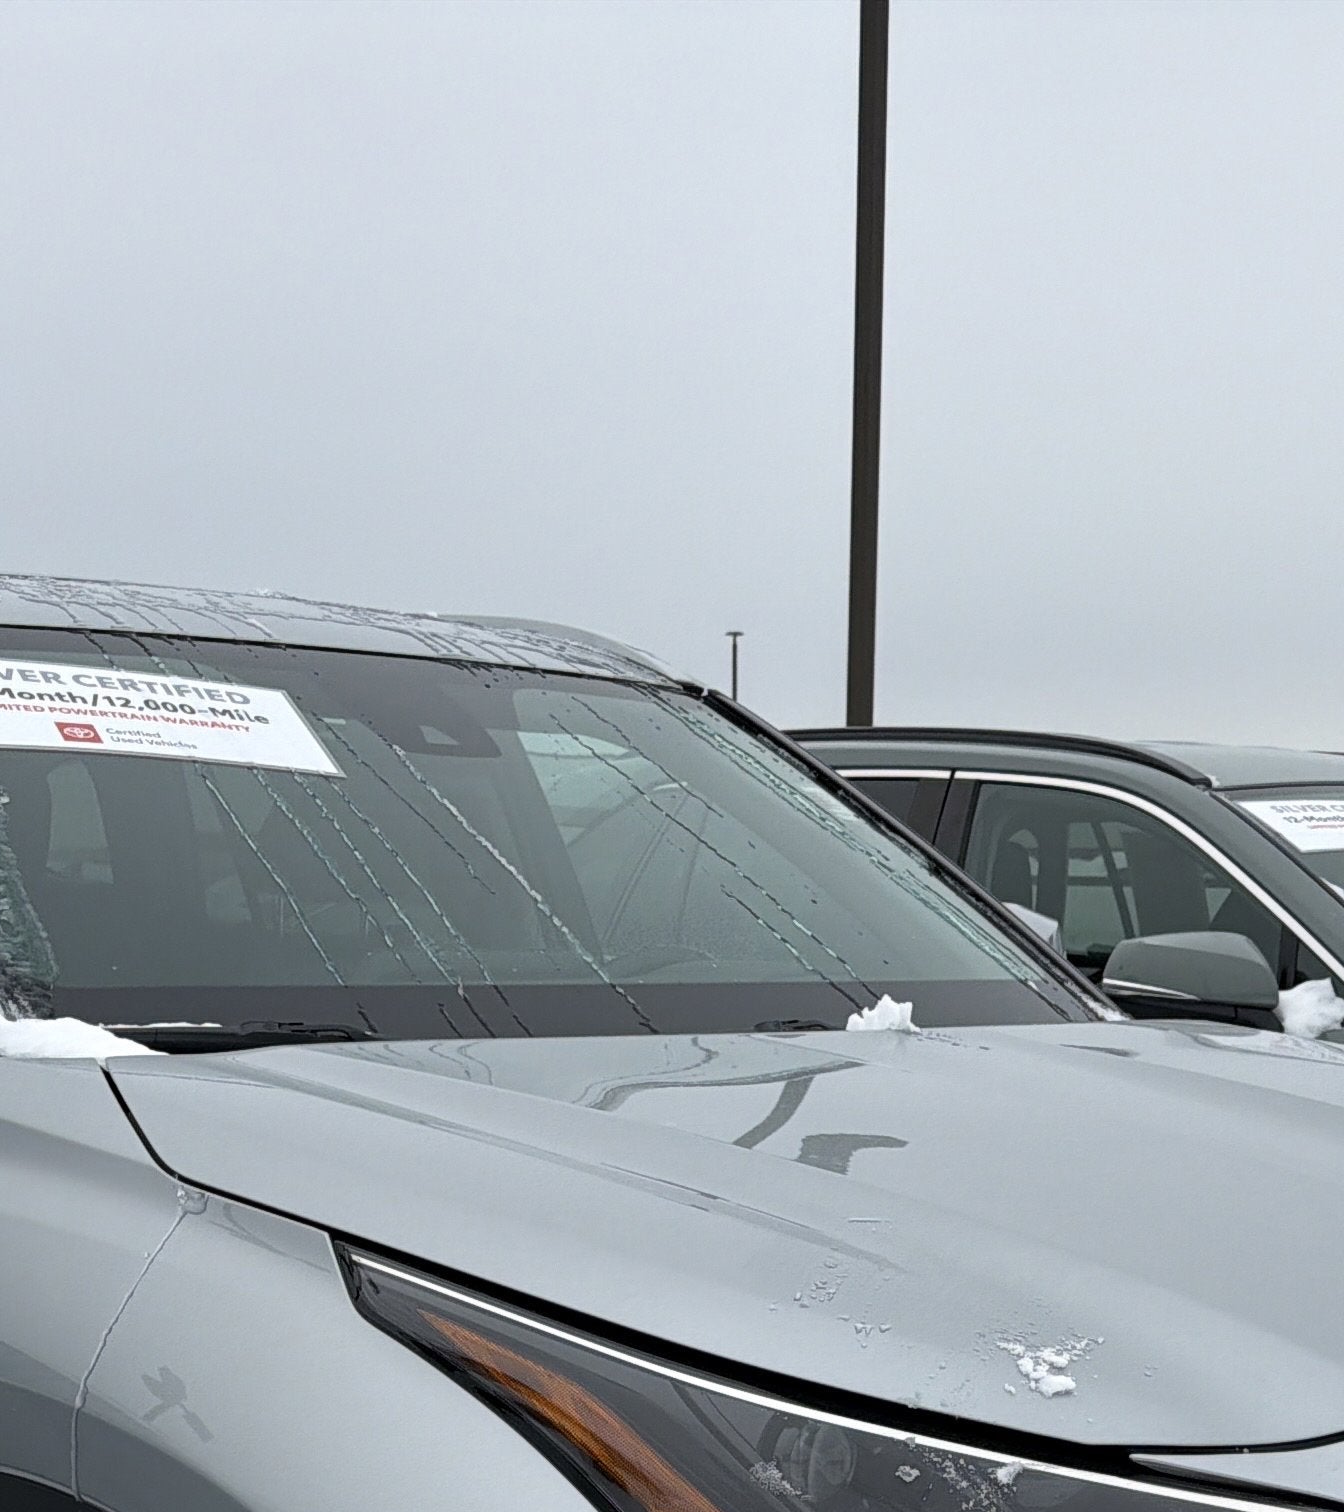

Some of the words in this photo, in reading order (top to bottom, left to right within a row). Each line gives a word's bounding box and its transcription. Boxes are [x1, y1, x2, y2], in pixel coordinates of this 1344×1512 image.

[71, 672, 253, 706] CERTIFIED
[47, 705, 158, 723] POWERTRAIN
[158, 714, 253, 733] WARRANTY
[106, 727, 161, 739] Certified
[111, 735, 142, 745] Used
[1270, 804, 1332, 814] SILVER
